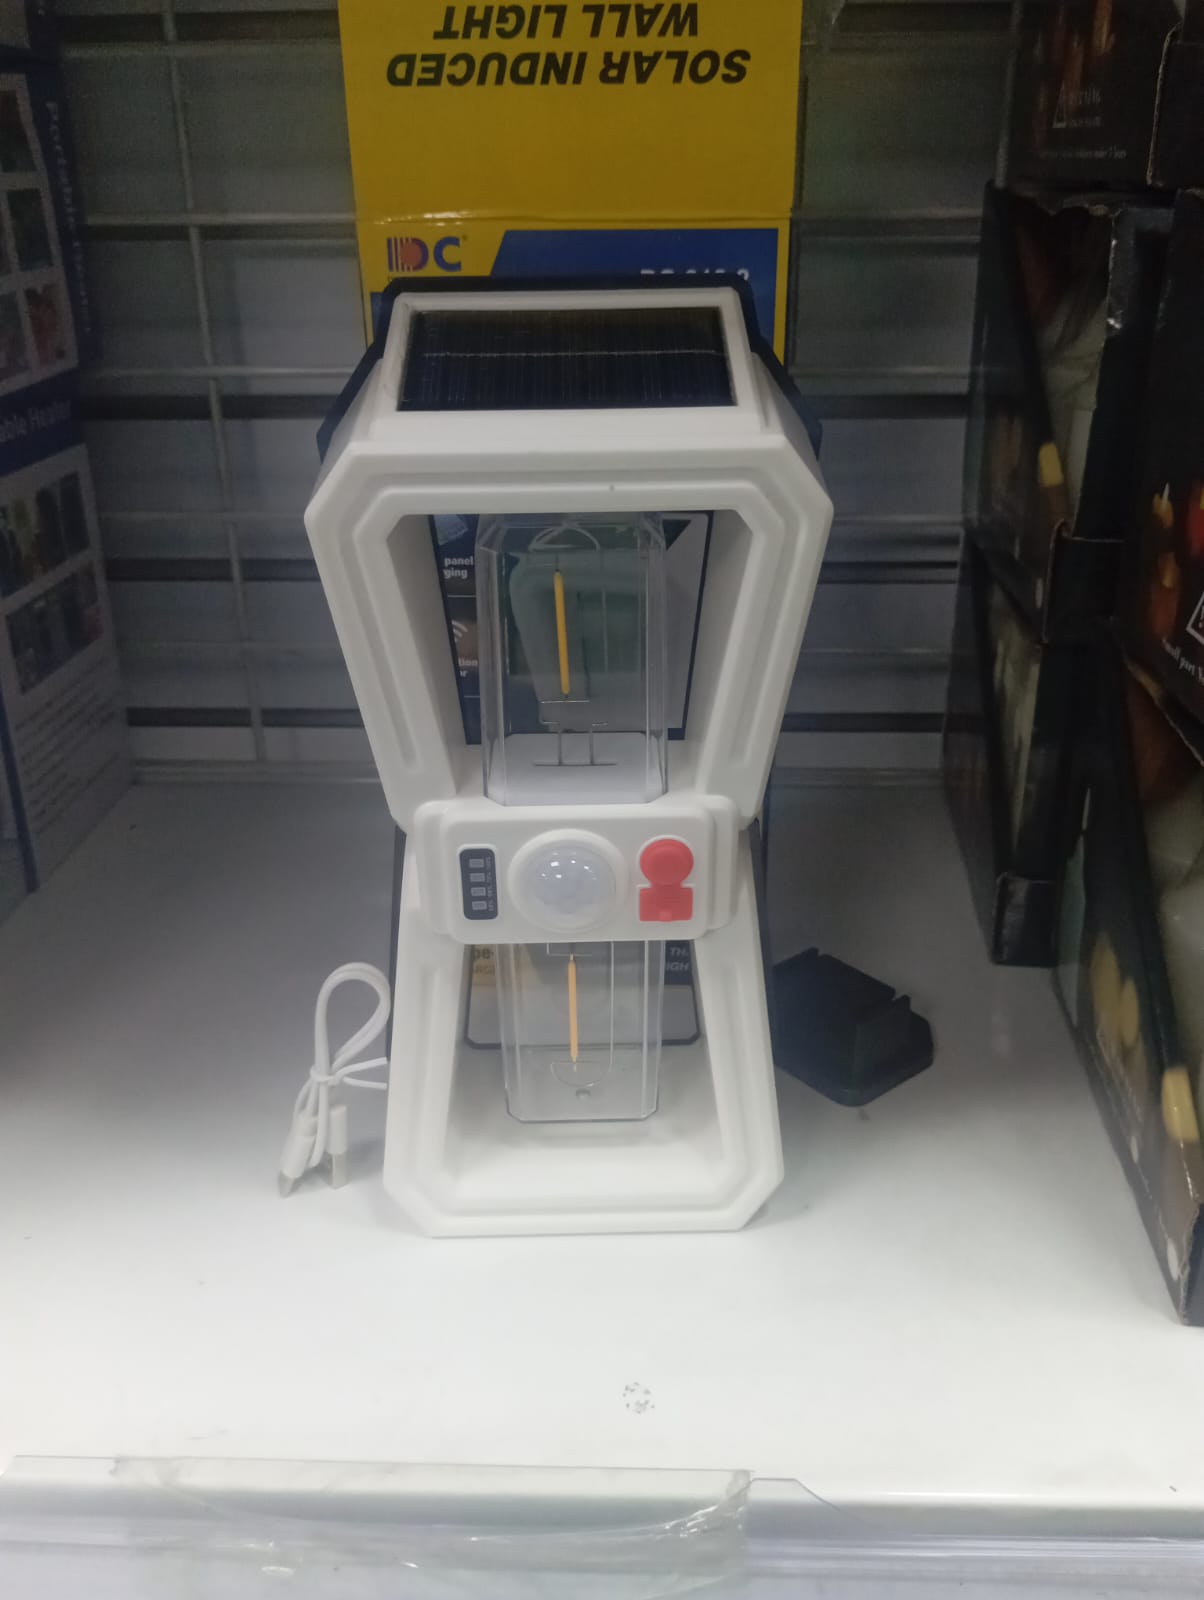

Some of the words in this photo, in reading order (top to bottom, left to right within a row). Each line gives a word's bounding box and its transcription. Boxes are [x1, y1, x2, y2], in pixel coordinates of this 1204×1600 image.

[433, 4, 566, 39] LIGHT
[582, 3, 699, 37] WALL
[387, 51, 588, 86] INDUCED
[599, 49, 751, 85] SOLAR
[443, 568, 469, 580] ging
[444, 556, 474, 567] panel
[457, 658, 478, 668] tion
